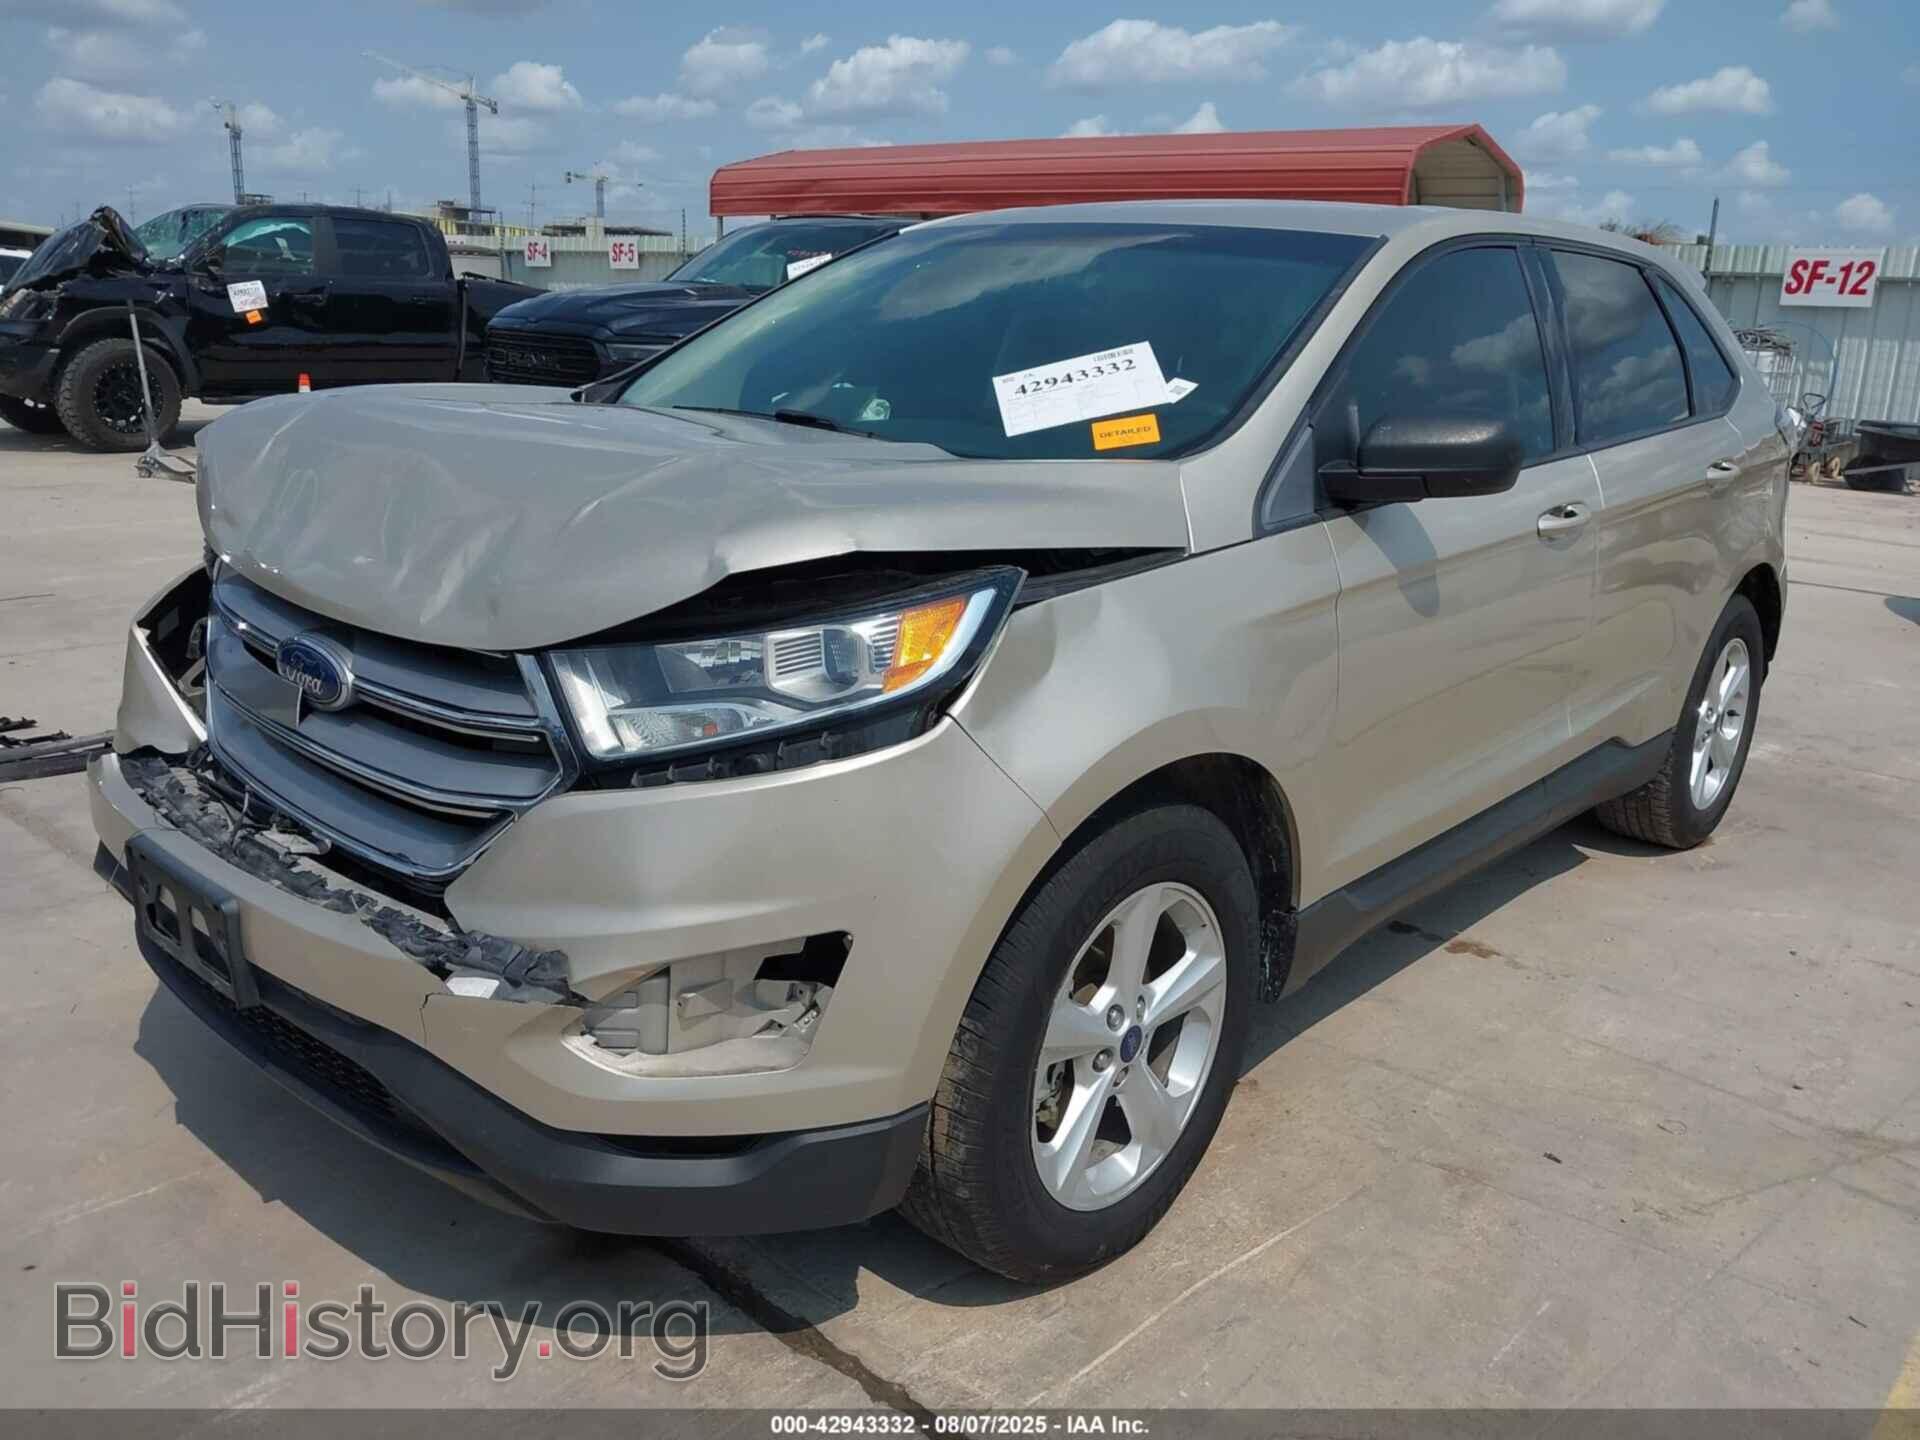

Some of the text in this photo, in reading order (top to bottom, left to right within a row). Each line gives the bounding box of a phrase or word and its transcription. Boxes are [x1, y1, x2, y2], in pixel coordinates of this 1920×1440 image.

[527, 241, 548, 262] SF-4
[611, 242, 635, 263] SF-5
[1784, 259, 1875, 295] SF-12
[1014, 358, 1137, 396] 42943332
[1099, 425, 1153, 439] DETAILED
